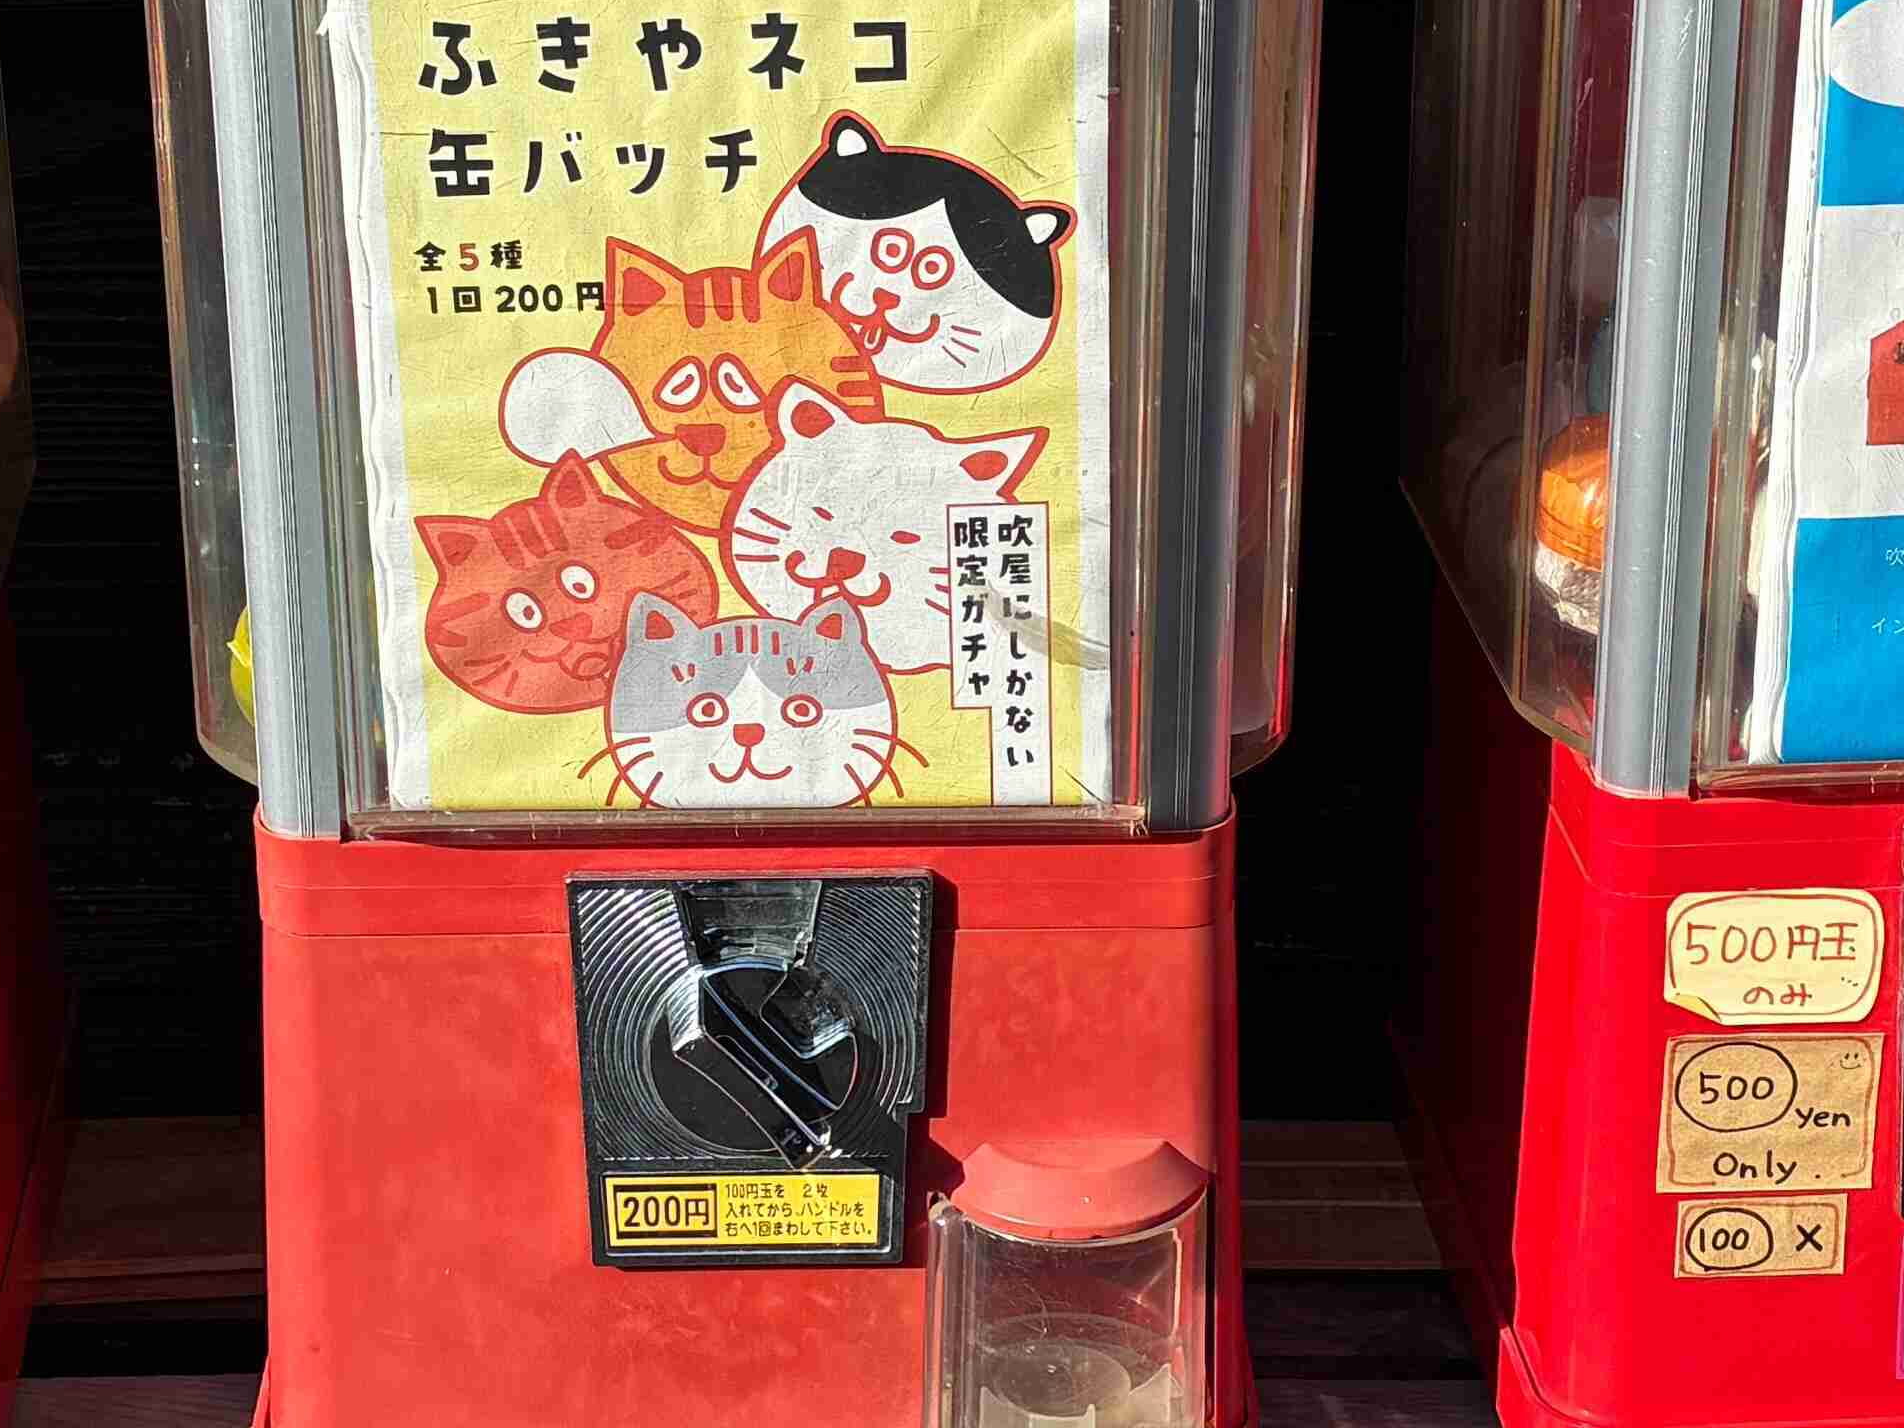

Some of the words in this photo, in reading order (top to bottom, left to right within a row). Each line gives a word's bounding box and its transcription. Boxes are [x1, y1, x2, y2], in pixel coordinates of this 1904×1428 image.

[418, 12, 909, 96] ふきやネコ
[428, 127, 758, 198] 缶バッチ
[414, 240, 523, 273] 全5種
[425, 283, 605, 315] 1回200円
[954, 516, 990, 695] 限定ガチャ
[998, 515, 1034, 766] 吹屋にしかない
[1686, 922, 1859, 964] 500円玉
[1743, 982, 1812, 1006] のみ
[1699, 1072, 1774, 1104] 500
[1796, 1107, 1851, 1129] yen
[623, 1195, 711, 1228] 200円
[1699, 1227, 1748, 1253] 100
